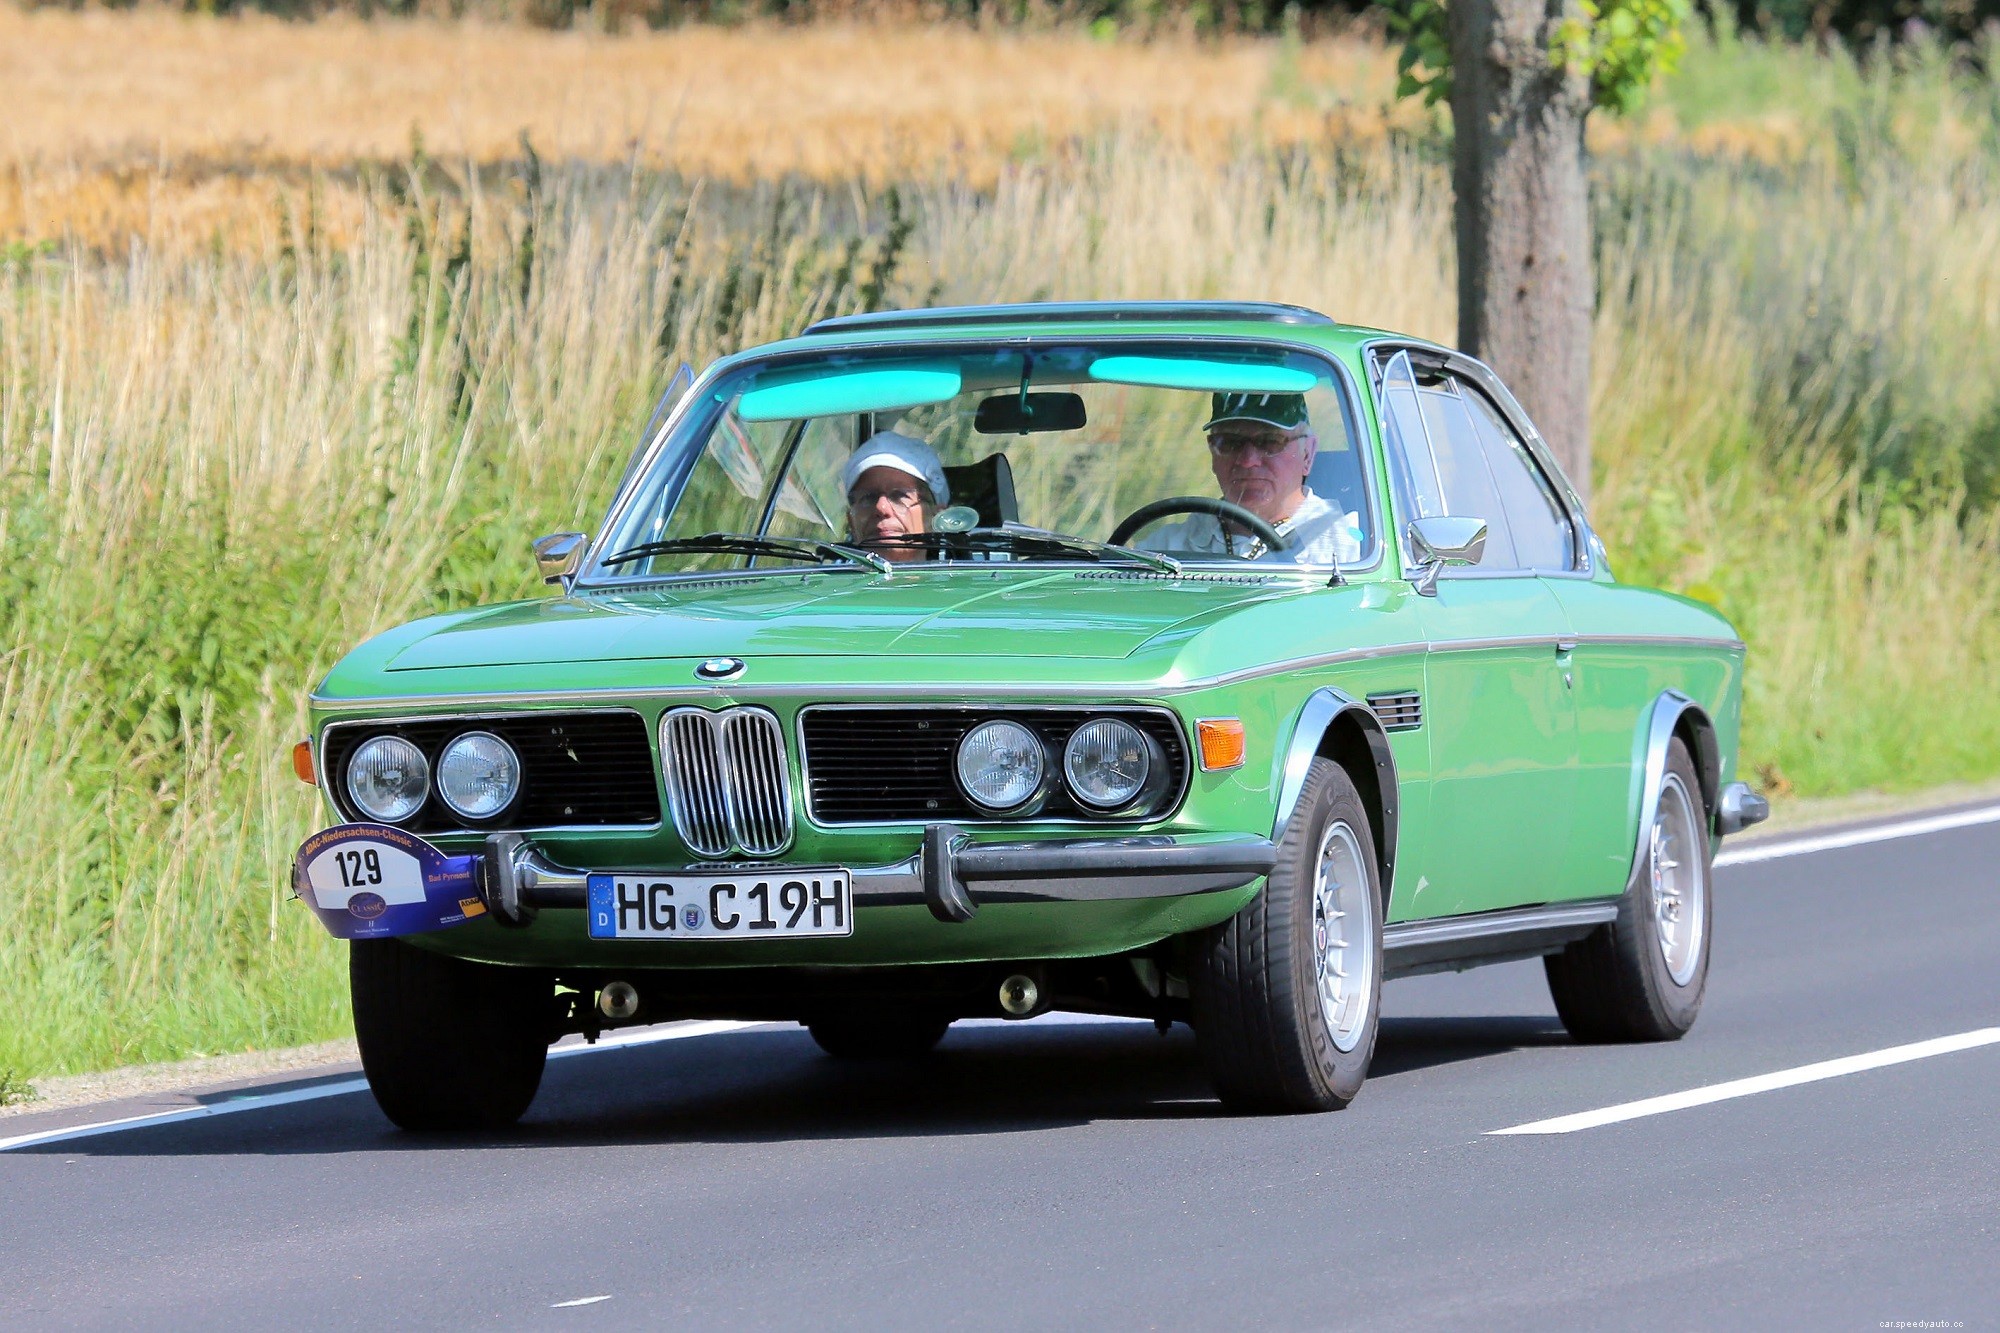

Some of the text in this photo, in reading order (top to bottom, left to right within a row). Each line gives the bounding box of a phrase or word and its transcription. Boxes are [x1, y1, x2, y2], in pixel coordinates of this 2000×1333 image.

[305, 827, 412, 856] ADAC-Niedersachsen-Classic
[335, 849, 382, 887] 129
[428, 874, 441, 883] Bad
[598, 912, 608, 926] D
[617, 883, 676, 931] HG
